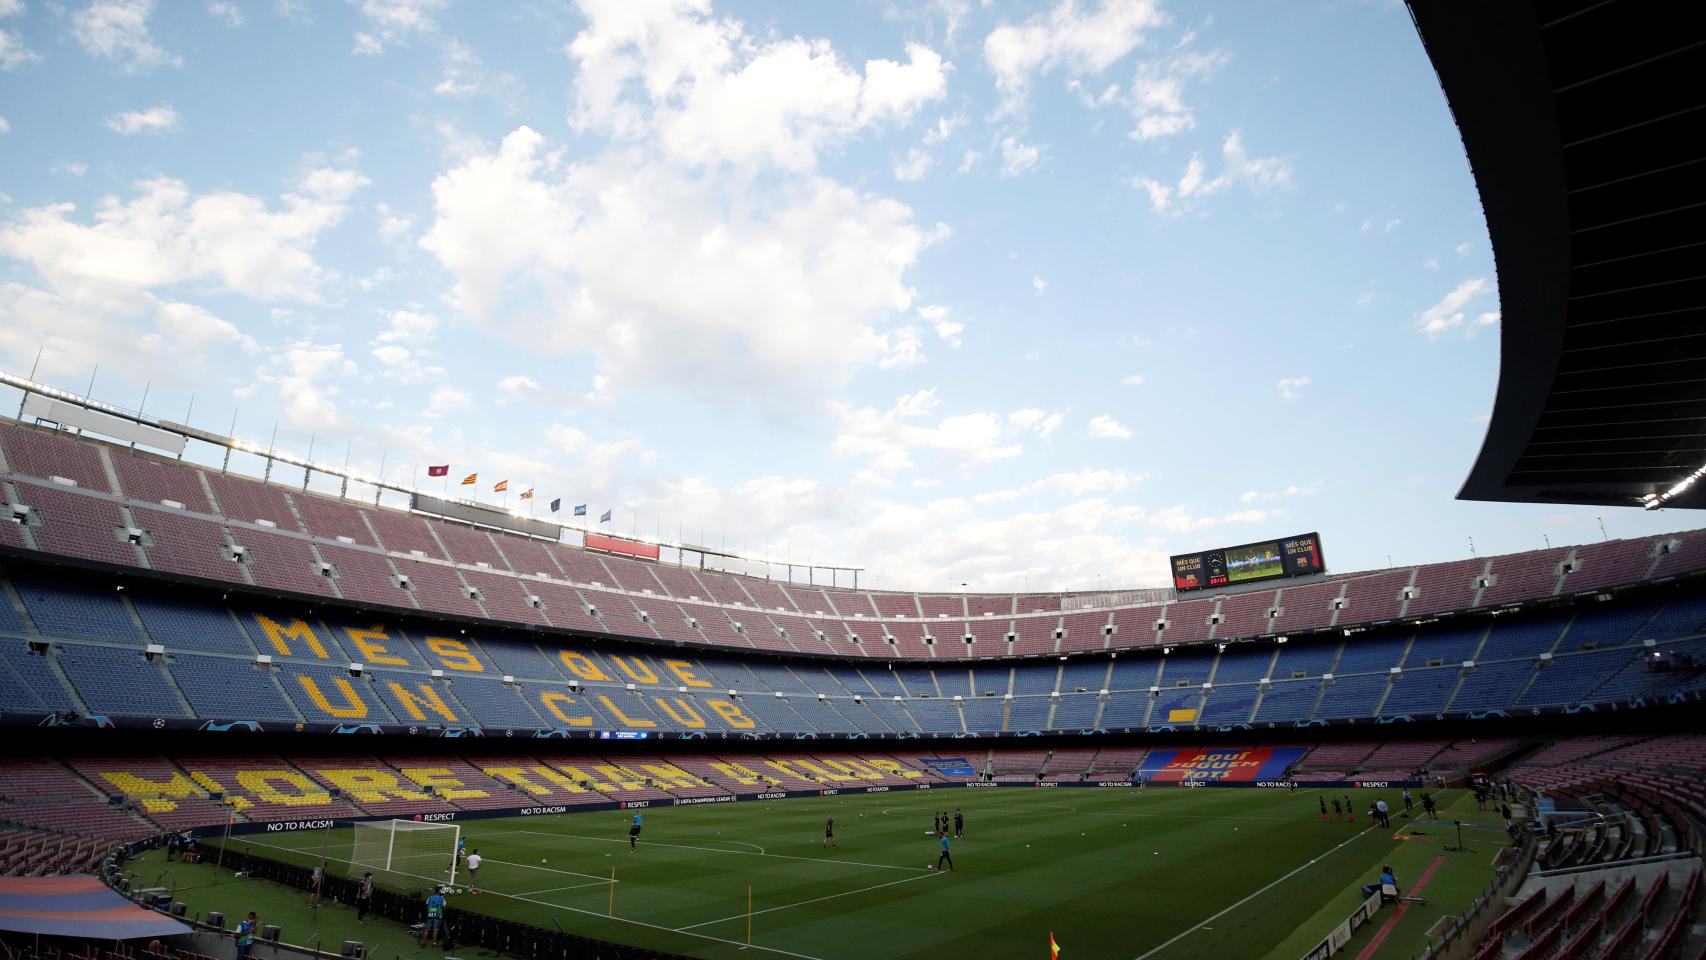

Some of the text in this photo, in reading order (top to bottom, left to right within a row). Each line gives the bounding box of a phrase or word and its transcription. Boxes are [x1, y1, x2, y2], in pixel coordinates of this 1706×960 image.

[1299, 539, 1313, 547] QUE
[1297, 545, 1313, 553] CLUB
[255, 613, 714, 688] MÉS QUE
[298, 675, 756, 729] UN CLUB
[98, 766, 491, 814] MORE
[521, 807, 532, 815] NO
[542, 805, 566, 813] RACISM
[424, 812, 455, 822] RESPECT
[267, 820, 334, 832] NO TO RACISM
